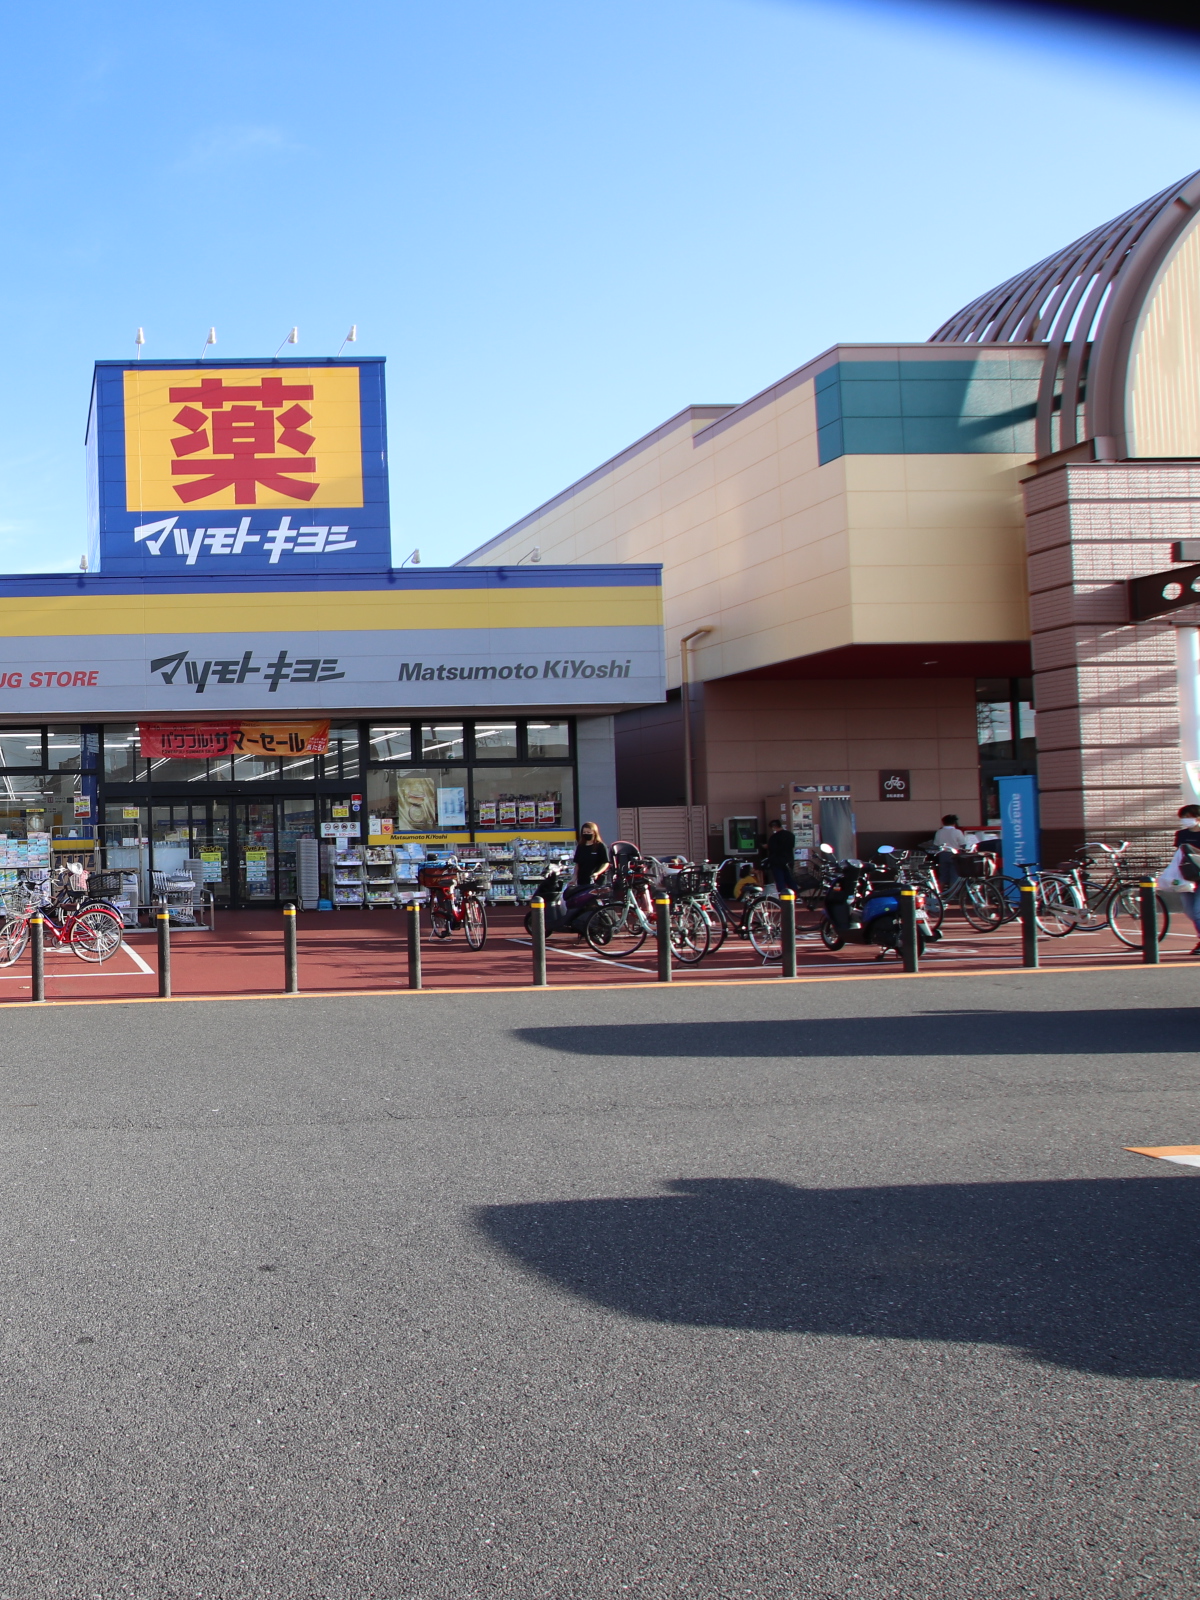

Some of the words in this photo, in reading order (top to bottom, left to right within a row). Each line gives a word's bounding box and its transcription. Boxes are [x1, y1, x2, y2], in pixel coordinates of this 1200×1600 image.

[168, 376, 321, 505] 薬
[133, 516, 358, 565] マツモトキヨシ
[29, 670, 99, 688] STORE
[150, 650, 346, 693] マツモトキヨシ
[398, 662, 538, 682] Matsumoto
[542, 659, 631, 679] KiYoshi
[1012, 793, 1022, 839] amazon
